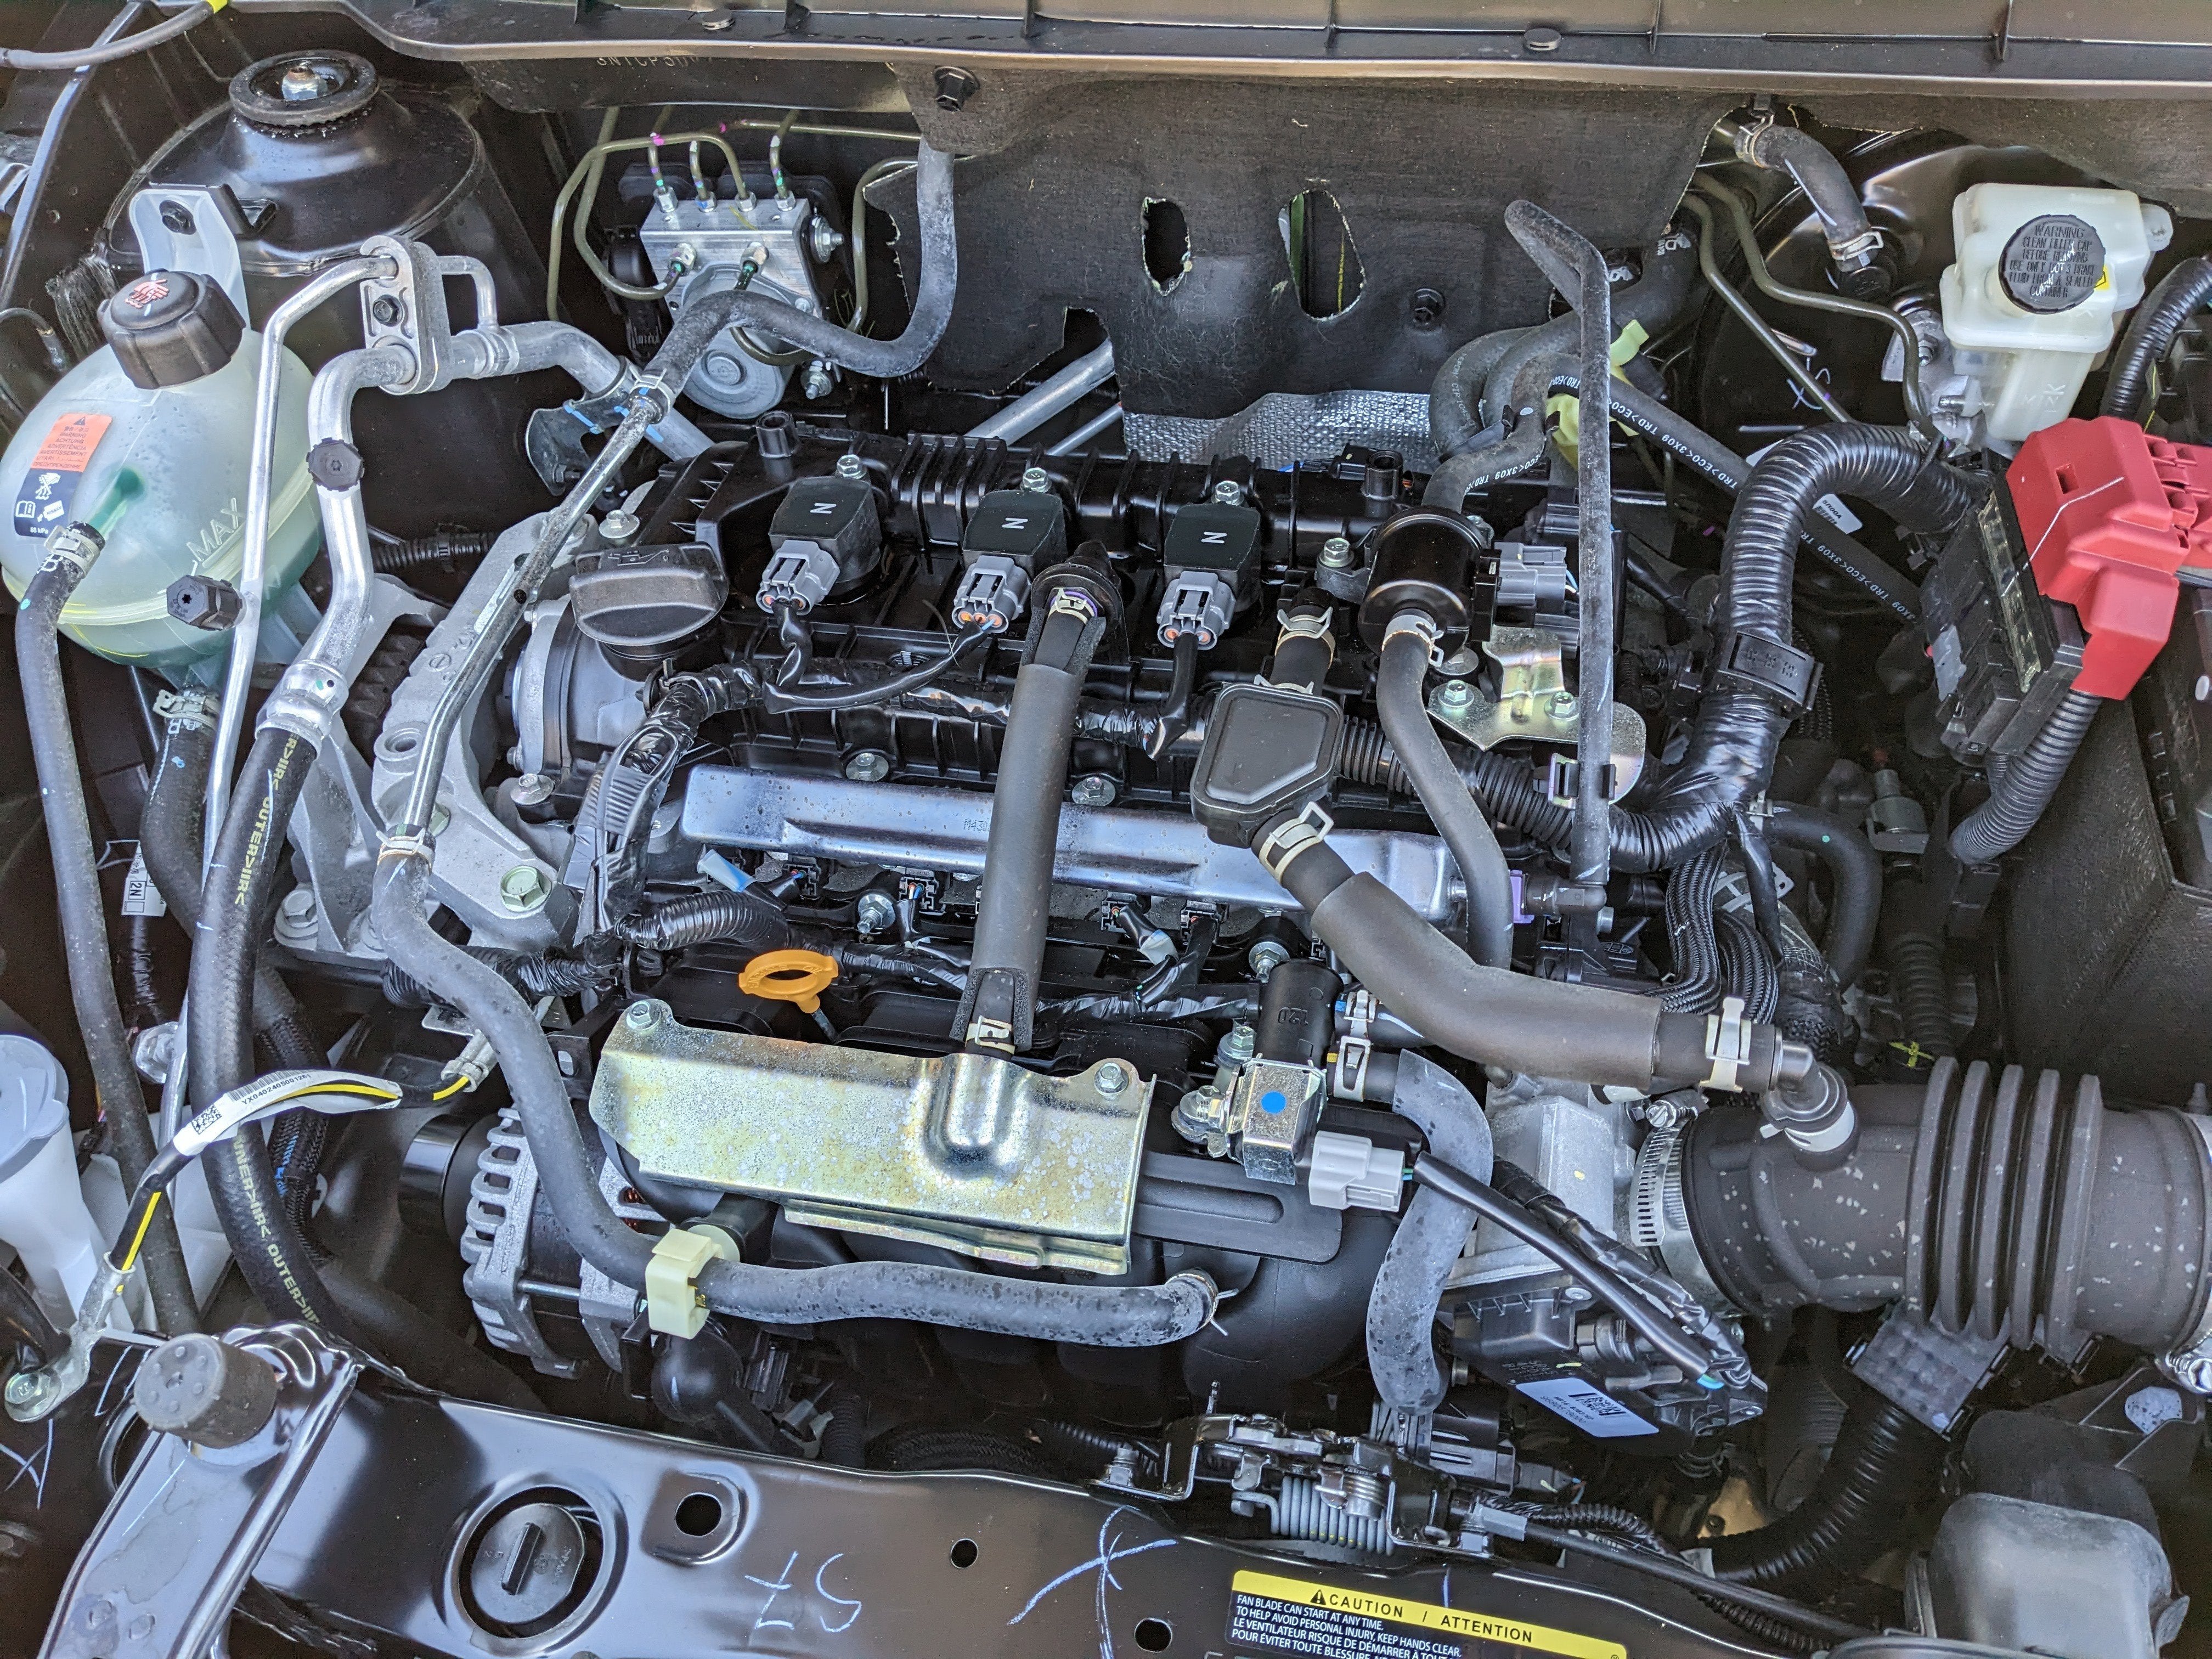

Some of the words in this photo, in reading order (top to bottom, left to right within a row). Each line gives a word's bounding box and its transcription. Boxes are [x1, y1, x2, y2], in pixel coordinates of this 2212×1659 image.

[2035, 225, 2085, 239] WARNING
[2023, 237, 2047, 248] CLEAN
[2078, 240, 2092, 251] CAP
[2023, 249, 2049, 261] BEFORE
[2053, 251, 2089, 262] REMOVING
[2010, 260, 2022, 271] USE
[2027, 262, 2046, 272] ONLY
[2049, 263, 2065, 273] DOT
[2066, 264, 2071, 274] 3
[2074, 264, 2095, 275] BRAKE
[2009, 272, 2029, 283] FLUID
[2032, 273, 2053, 285] FROM
[2056, 275, 2061, 285] A
[2066, 276, 2093, 287] SEALED
[2030, 285, 2068, 298] CONTAINER
[47, 506, 62, 515] NISSAN
[187, 498, 245, 561] MAX
[130, 883, 143, 896] 2N
[1237, 1595, 1254, 1606] FAN
[1255, 1598, 1282, 1611] BLADE
[1284, 1604, 1302, 1615] CAN
[1304, 1607, 1329, 1620] START
[1331, 1612, 1341, 1621] AT
[1342, 1614, 1360, 1625] ANY
[1362, 1618, 1384, 1630] TIME.
[1329, 1594, 1403, 1618] CAUTION
[1422, 1611, 1427, 1622] /
[1441, 1615, 1532, 1643] ATTENTION
[1234, 1618, 1244, 1627] LE
[1246, 1620, 1306, 1640] VENTILATEUR
[1308, 1633, 1342, 1646] RISQUE
[1344, 1638, 1357, 1649] DE
[1359, 1640, 1410, 1659] DÉMARRER
[1412, 1649, 1419, 1659] À
[1237, 1606, 1248, 1616] TO
[1250, 1609, 1270, 1620] HELP
[1272, 1613, 1299, 1626] AVOID
[1300, 1620, 1344, 1635] PERSONAL
[1345, 1627, 1376, 1642] INJURY,
[1378, 1633, 1398, 1644] KEEP
[1400, 1637, 1430, 1651] HANDS
[1432, 1643, 1462, 1657] CLEAR.
[1232, 1629, 1258, 1643] POUR
[1260, 1633, 1290, 1649] ÉVITER
[1293, 1639, 1322, 1655] TOUTE
